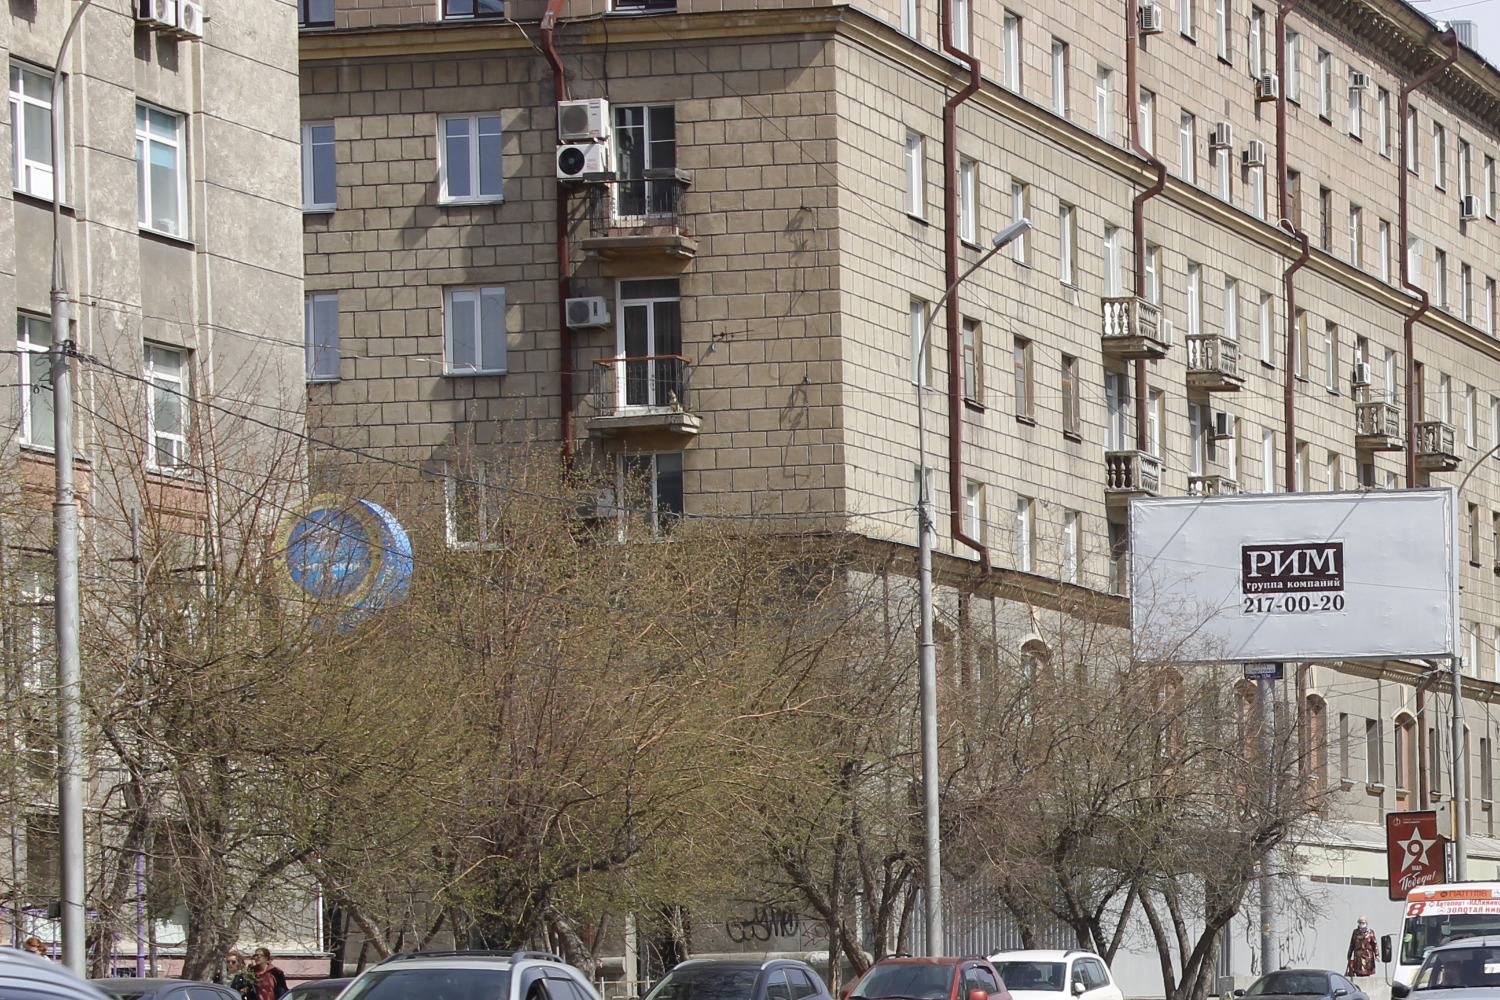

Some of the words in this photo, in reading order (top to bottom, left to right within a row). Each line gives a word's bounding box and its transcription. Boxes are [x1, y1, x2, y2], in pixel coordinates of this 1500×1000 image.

[1246, 548, 1339, 578] РИМ
[1246, 581, 1284, 592] группа
[1287, 577, 1341, 589] компаний
[1243, 594, 1345, 614] 217-00-20
[1398, 870, 1437, 891] Победа!
[1406, 902, 1426, 917] 8
[1446, 906, 1484, 914] ЗОЛОТАЯ
